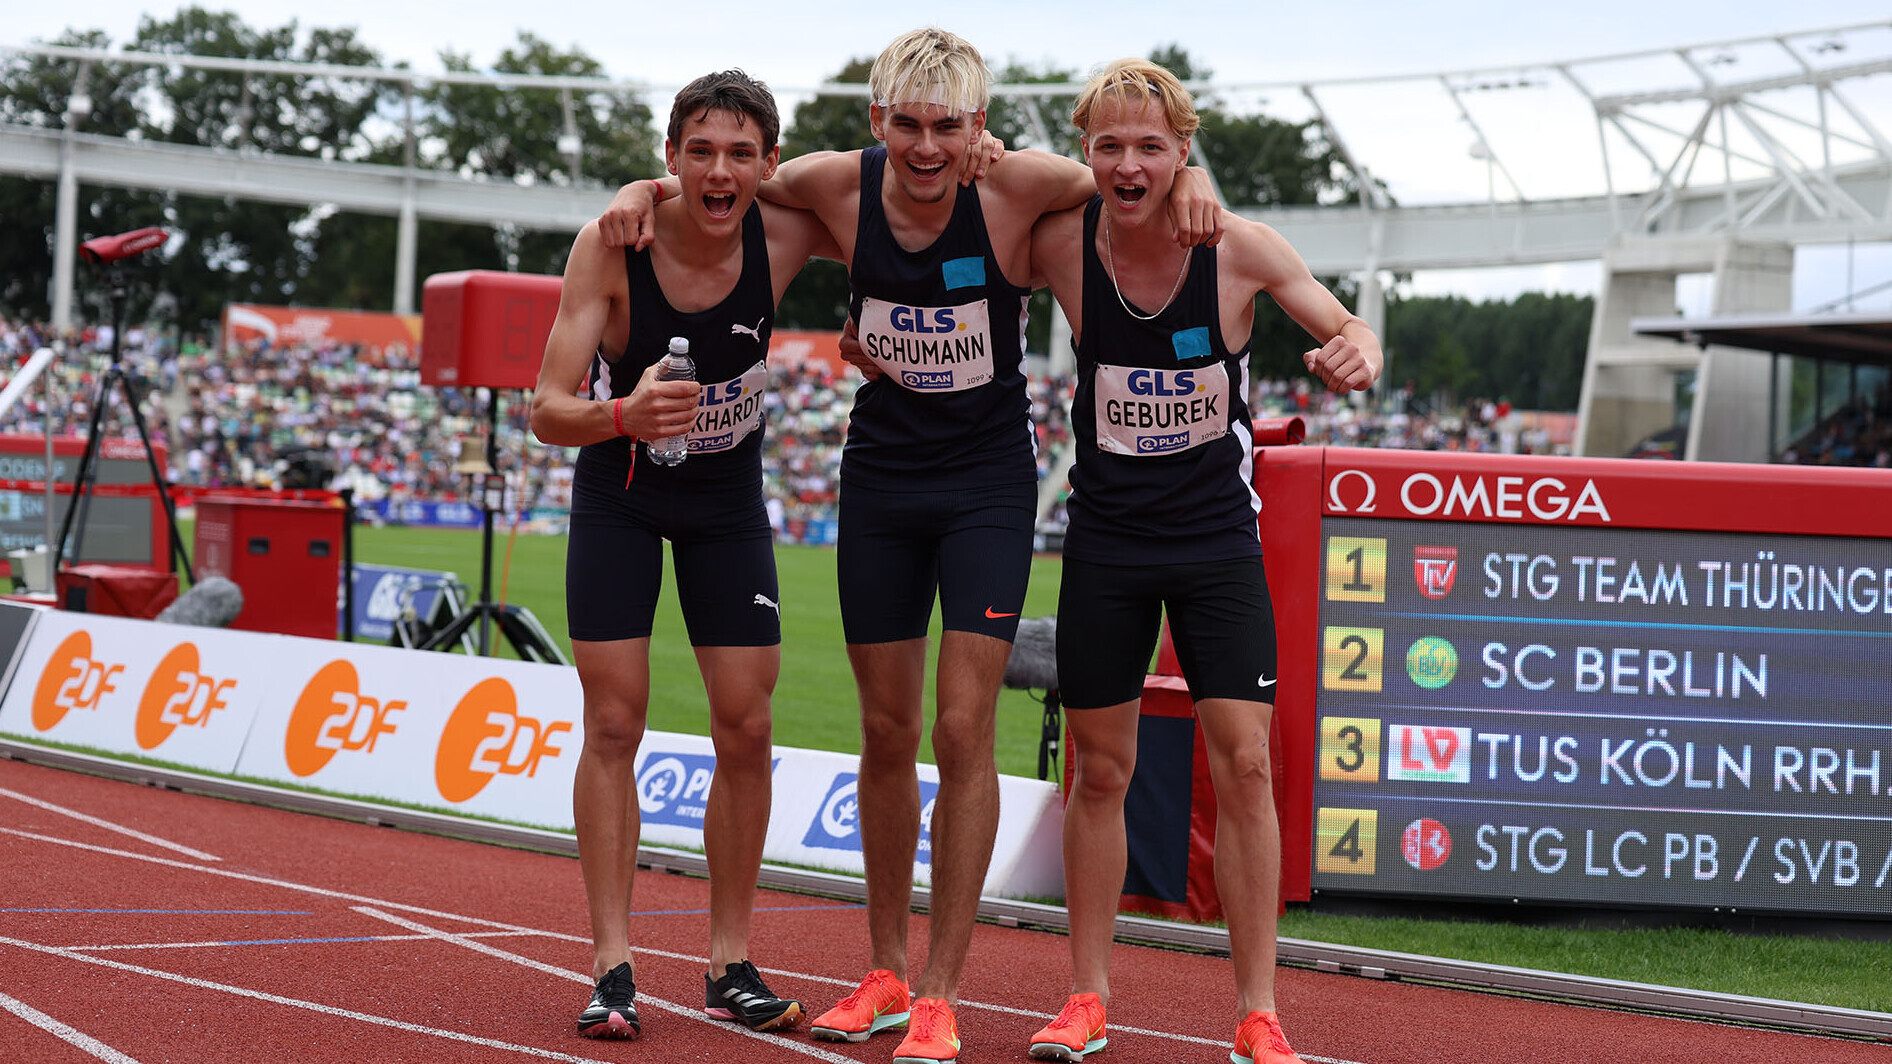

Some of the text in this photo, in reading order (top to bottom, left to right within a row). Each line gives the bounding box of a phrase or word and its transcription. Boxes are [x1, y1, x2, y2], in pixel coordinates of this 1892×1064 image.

[866, 332, 984, 365] SCHUMANN
[922, 374, 951, 383] PLAN
[967, 374, 985, 385] 1099
[1106, 394, 1219, 428] GEBUREK
[704, 435, 731, 445] PLAN
[1159, 435, 1188, 447] PLAN
[1400, 472, 1611, 522] OMEGA
[1343, 546, 1371, 591] 1
[1483, 552, 1560, 600] STG
[1572, 556, 1689, 606] TEAM
[54, 656, 126, 711] ZDF
[1339, 634, 1768, 699] 2 SC BERLIN
[160, 671, 238, 728] ZDF
[314, 690, 408, 754] ZDF
[468, 711, 574, 778] ZDF
[1336, 725, 1365, 771] 3
[1478, 732, 1579, 783] TUS
[1601, 728, 1751, 790] KÖLN
[1328, 817, 1363, 864] 4
[1476, 824, 1567, 873] STG
[1585, 829, 1647, 878] LC
[1664, 832, 1719, 881] PB
[1734, 836, 1759, 882] /
[1773, 837, 1860, 887] SVB
